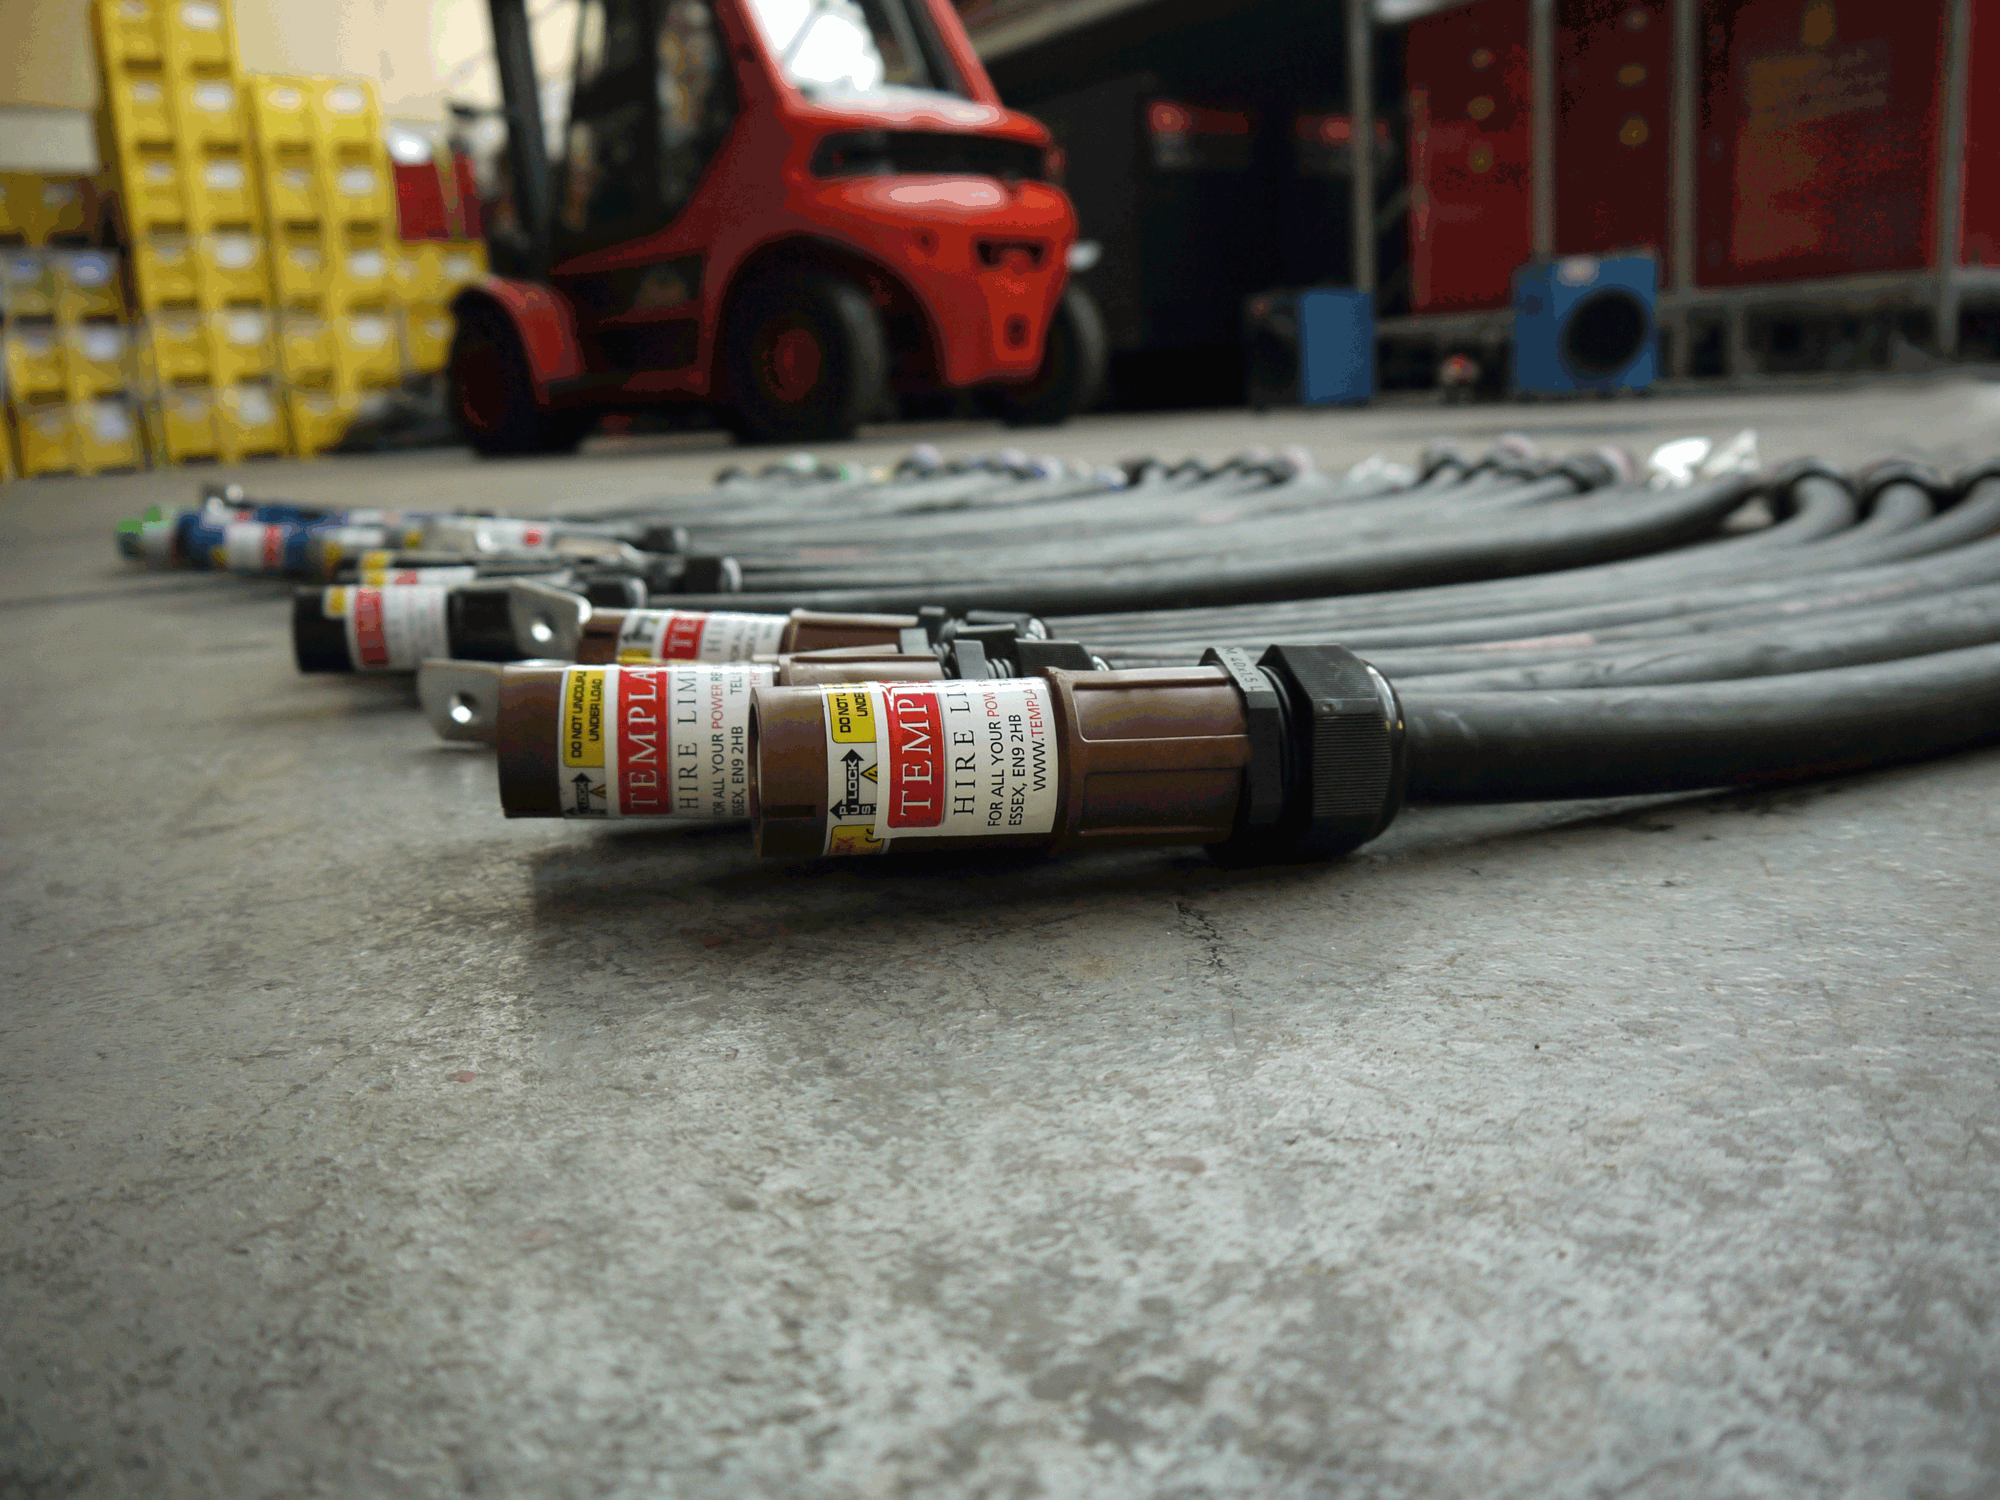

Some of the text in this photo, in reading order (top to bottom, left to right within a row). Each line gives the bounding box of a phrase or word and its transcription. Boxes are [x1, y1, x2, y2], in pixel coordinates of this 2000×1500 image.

[571, 671, 587, 758] DO NOT UNCOUPL
[589, 679, 602, 742] UNDER LOAD
[711, 684, 723, 729] POWER
[836, 696, 850, 716] NOT
[839, 717, 852, 734] DO
[712, 733, 724, 775] YOUR
[731, 726, 744, 755] 2HB
[989, 721, 1004, 766] YOUR
[678, 742, 698, 811] HIRE
[713, 777, 725, 799] ALL
[731, 758, 744, 784] EN9
[847, 759, 858, 799] LOCK
[953, 728, 976, 816] HIRE
[991, 769, 1004, 797] ALL
[1008, 714, 1028, 826] ESSEX, EN9 2HB
[988, 801, 1003, 827] FOR
